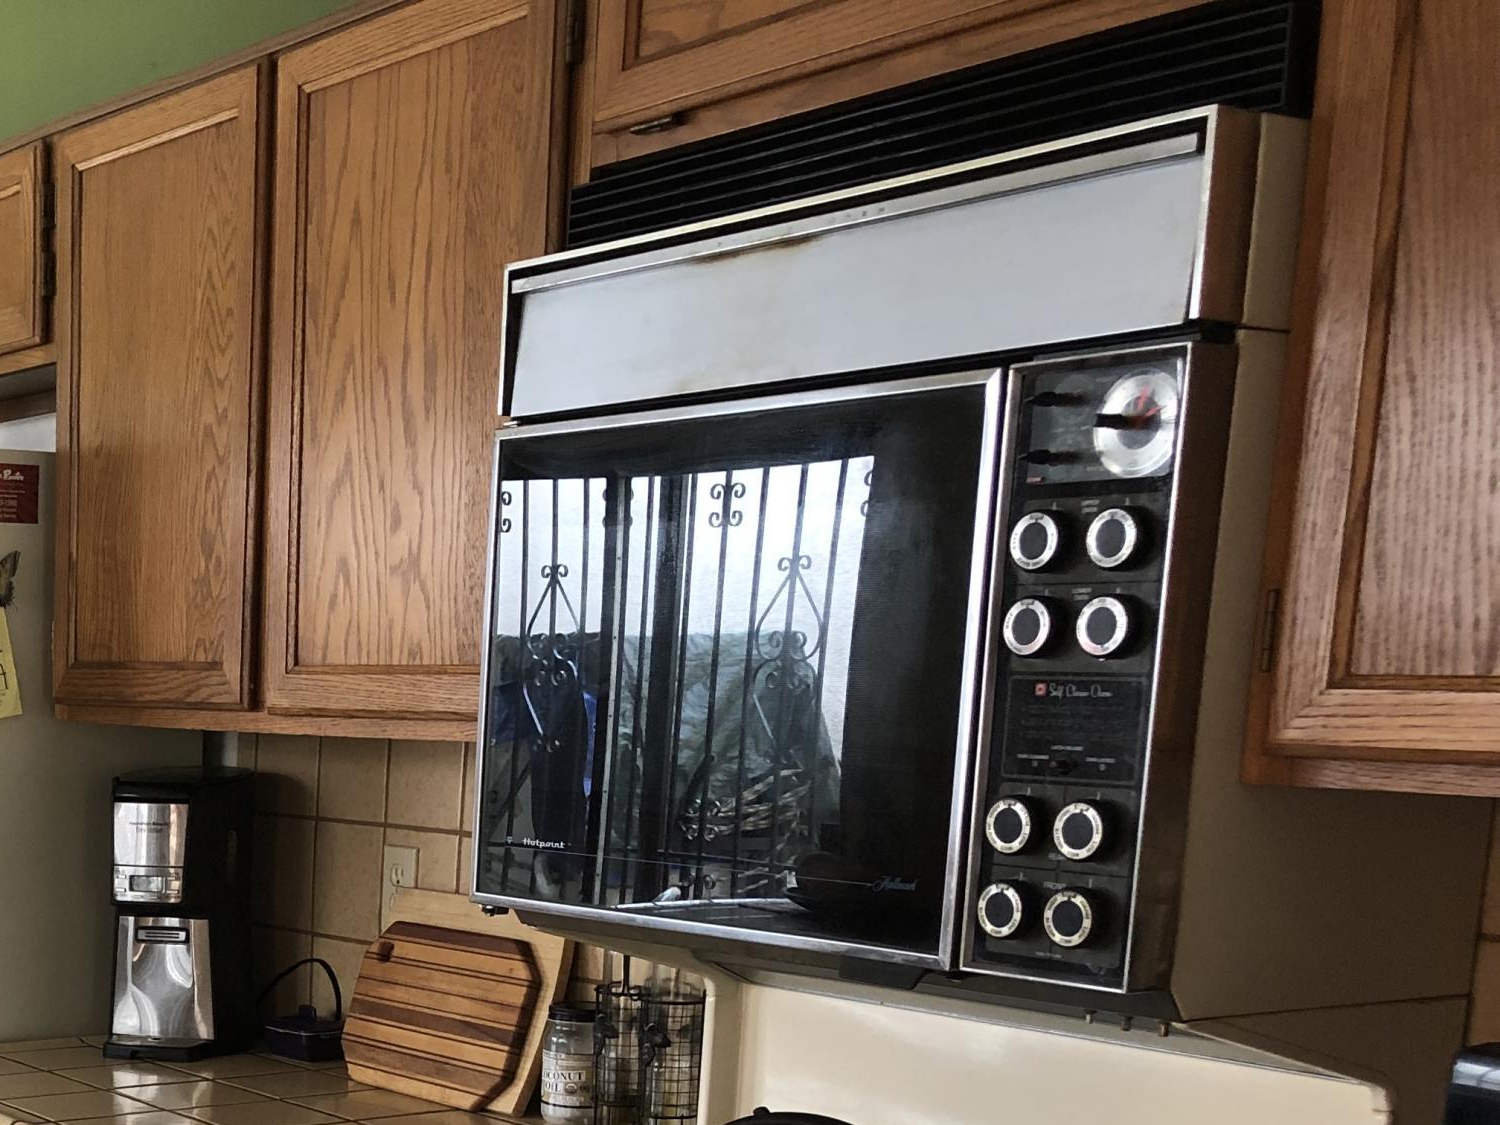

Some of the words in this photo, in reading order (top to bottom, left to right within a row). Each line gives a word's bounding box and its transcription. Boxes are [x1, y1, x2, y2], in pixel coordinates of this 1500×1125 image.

[522, 837, 565, 849] Hotpoint
[543, 1071, 585, 1081] OCONUT
[545, 1082, 560, 1092] OIL
